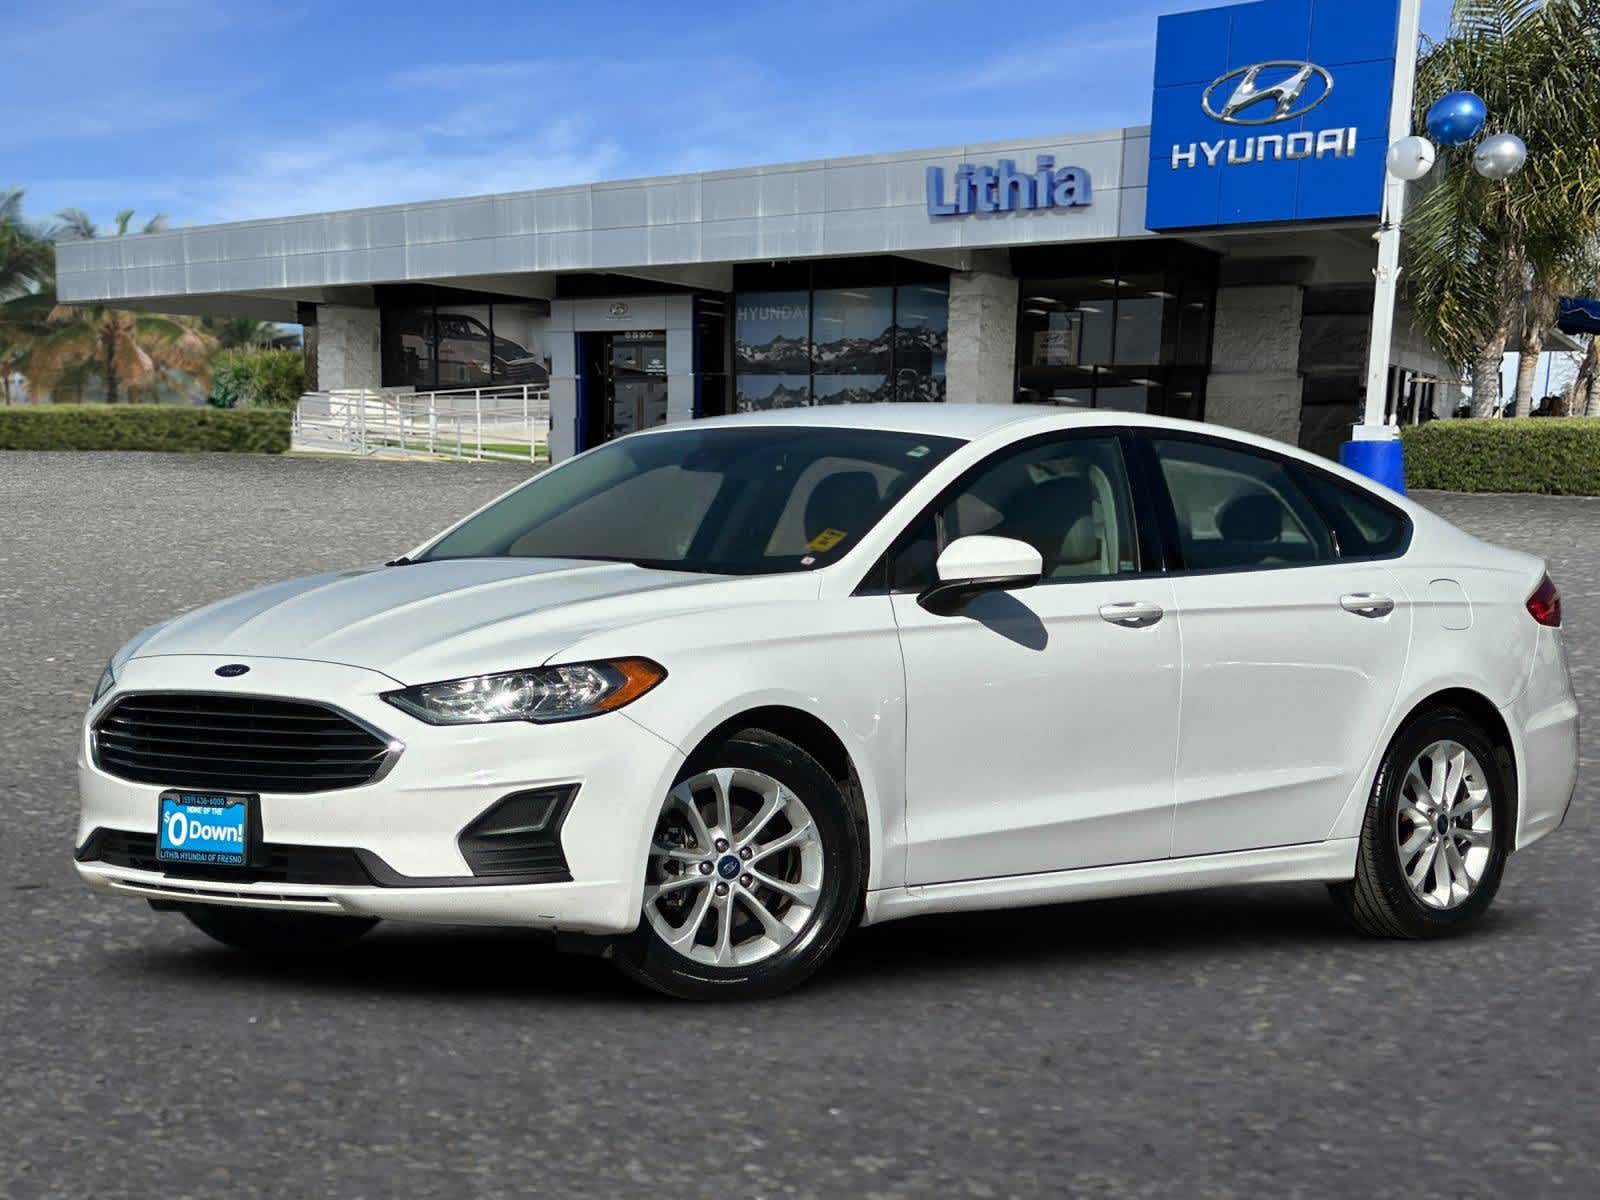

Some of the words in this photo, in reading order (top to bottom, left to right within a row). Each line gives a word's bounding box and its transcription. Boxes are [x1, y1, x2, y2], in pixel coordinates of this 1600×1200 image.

[1171, 127, 1357, 169] HYUNDAI
[926, 154, 1093, 216] Lithia
[737, 304, 808, 321] HYUNDAI
[189, 820, 243, 843] Down!
[180, 851, 207, 861] HYUNDAI
[207, 853, 217, 862] OF
